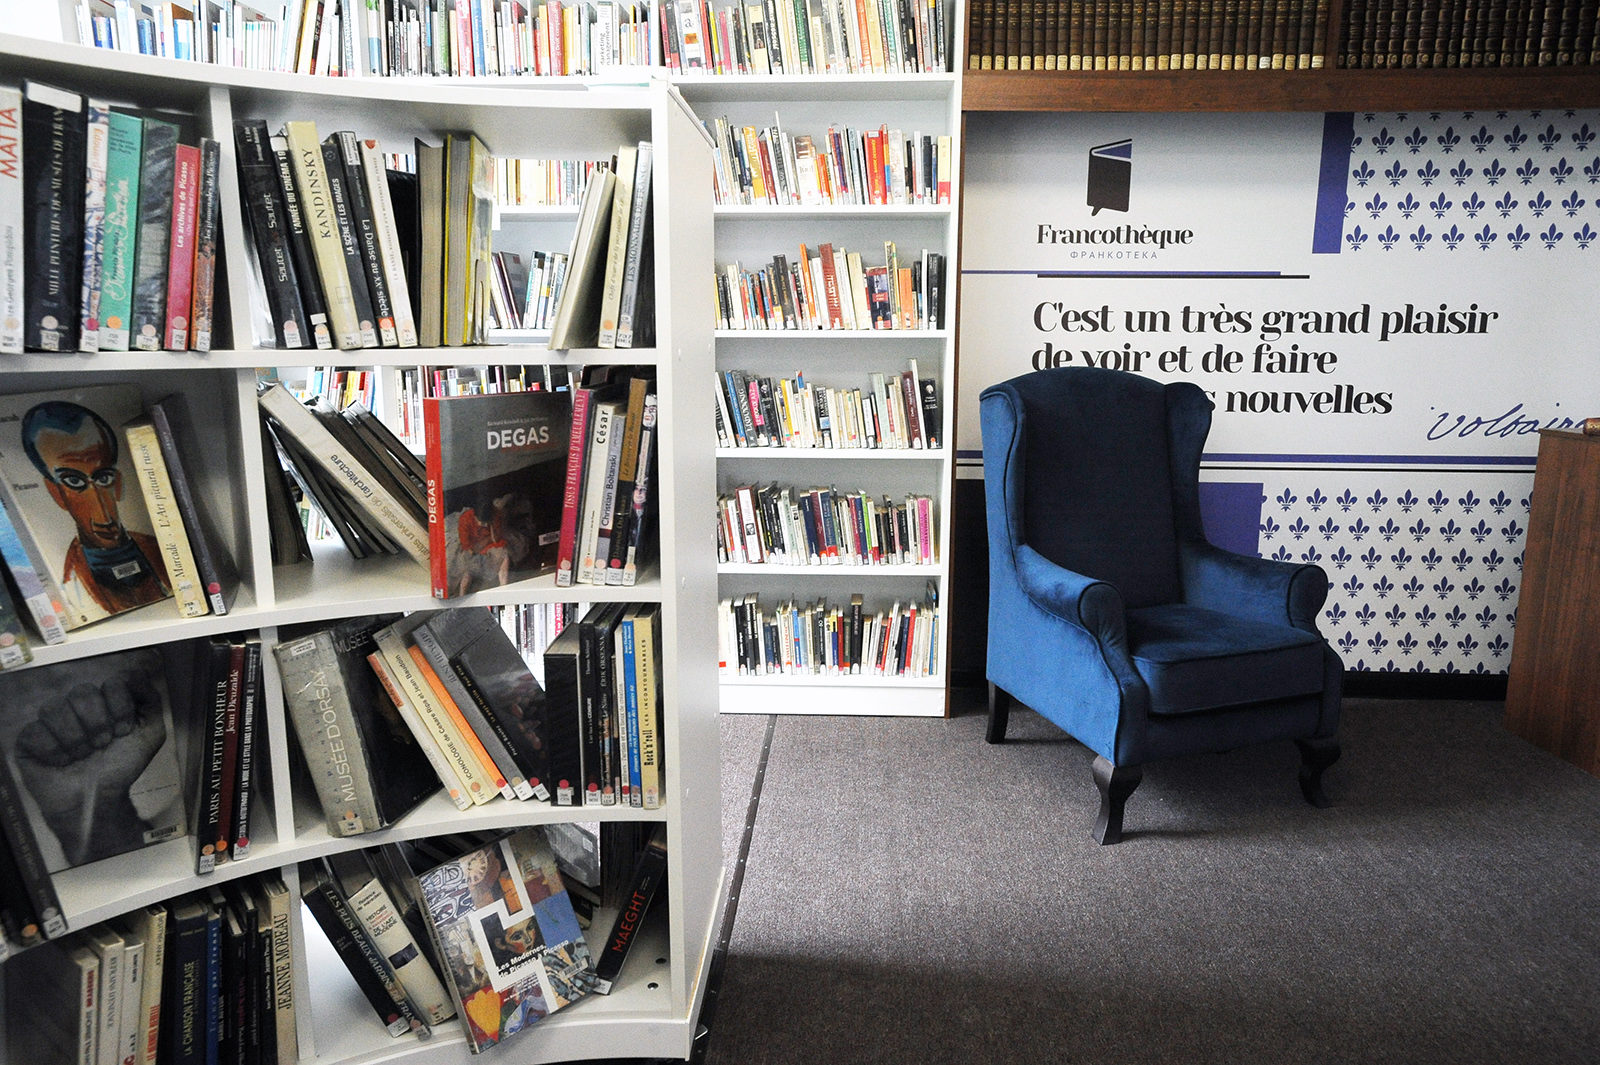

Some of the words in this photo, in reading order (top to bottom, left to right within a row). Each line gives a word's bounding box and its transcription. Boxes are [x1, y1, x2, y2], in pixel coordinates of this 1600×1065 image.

[179, 161, 188, 188] Picasso
[279, 161, 293, 191] CINÉMA
[178, 191, 186, 200] de
[286, 191, 296, 202] DU
[301, 146, 330, 238] KANDINSKY
[331, 177, 344, 203] IMAGES
[176, 202, 186, 233] archives
[261, 192, 277, 228] Sautet
[288, 203, 303, 234] L'ANNÉE
[336, 203, 346, 216] LES
[339, 216, 348, 226] ET
[633, 200, 643, 214] DE
[341, 226, 352, 245] SCÈNE
[361, 218, 371, 231] La
[627, 215, 641, 263] MONNAIES
[1037, 223, 1194, 249] Francothèque
[175, 234, 184, 247] Les
[345, 246, 354, 255] LA
[364, 231, 378, 260] Danse
[1070, 250, 1158, 260] ФРАНКОТЕКА
[272, 246, 288, 282] Sautet
[370, 261, 381, 274] au
[625, 265, 635, 282] LES
[377, 289, 391, 317] siècle
[1034, 301, 1115, 334] C'est
[1124, 310, 1171, 334] un
[1181, 303, 1252, 334] très
[1260, 304, 1370, 342] grand
[1379, 303, 1498, 342] plaisir
[1031, 343, 1073, 371] de
[1081, 343, 1150, 372] voir
[1158, 346, 1194, 373] et
[1202, 344, 1243, 373] de
[1252, 344, 1338, 374] faire
[1226, 385, 1393, 415] nouvelles
[570, 393, 585, 451] D'AMEUBLEMENT
[596, 409, 608, 444] César
[486, 426, 550, 450] DEGAS
[328, 452, 374, 499] l'architecture
[566, 451, 579, 484] FRANÇAIS
[604, 453, 617, 489] Boltanski
[144, 466, 163, 502] pictural
[564, 485, 575, 508] TISSUS
[154, 502, 170, 529] L'Art
[426, 479, 437, 523] DEGAS
[600, 491, 612, 526] Christian
[378, 504, 415, 542] universalis
[165, 542, 185, 578] Marcadé
[393, 653, 412, 679] Baudoin
[598, 636, 606, 669] ORSENNA
[227, 669, 238, 711] Dieuzaide
[408, 678, 421, 694] Jean
[417, 692, 425, 700] et
[214, 679, 227, 737] BONHEUR
[310, 668, 341, 739] D'ORSAY
[421, 698, 433, 714] Ripa
[226, 713, 236, 733] Jean
[441, 732, 451, 742] de
[212, 739, 223, 771] PETIT
[446, 740, 474, 780] ICONOLOGIE
[642, 729, 653, 765] Rock'n'roll
[211, 775, 221, 789] AU
[327, 738, 356, 802] MUSÉE
[209, 792, 220, 823] PARIS
[365, 904, 387, 921] HISTOIRE
[372, 925, 381, 933] DE
[380, 915, 394, 928] L'ART
[610, 889, 647, 953] MAEGHT
[273, 913, 289, 962] MOREAU
[373, 918, 397, 938] MODERNE
[325, 889, 341, 908] LES
[337, 906, 355, 929] PLUS
[351, 928, 372, 956] BEAUX
[368, 955, 394, 990] JARDINS
[397, 1000, 415, 1023] FRAN
[509, 942, 547, 965] Modernes,
[542, 938, 569, 956] Picasso
[183, 961, 194, 1004] FRANÇAISE
[276, 962, 291, 1009] JEANNE
[182, 1005, 193, 1044] CHANSON
[182, 1046, 192, 1055] LA
